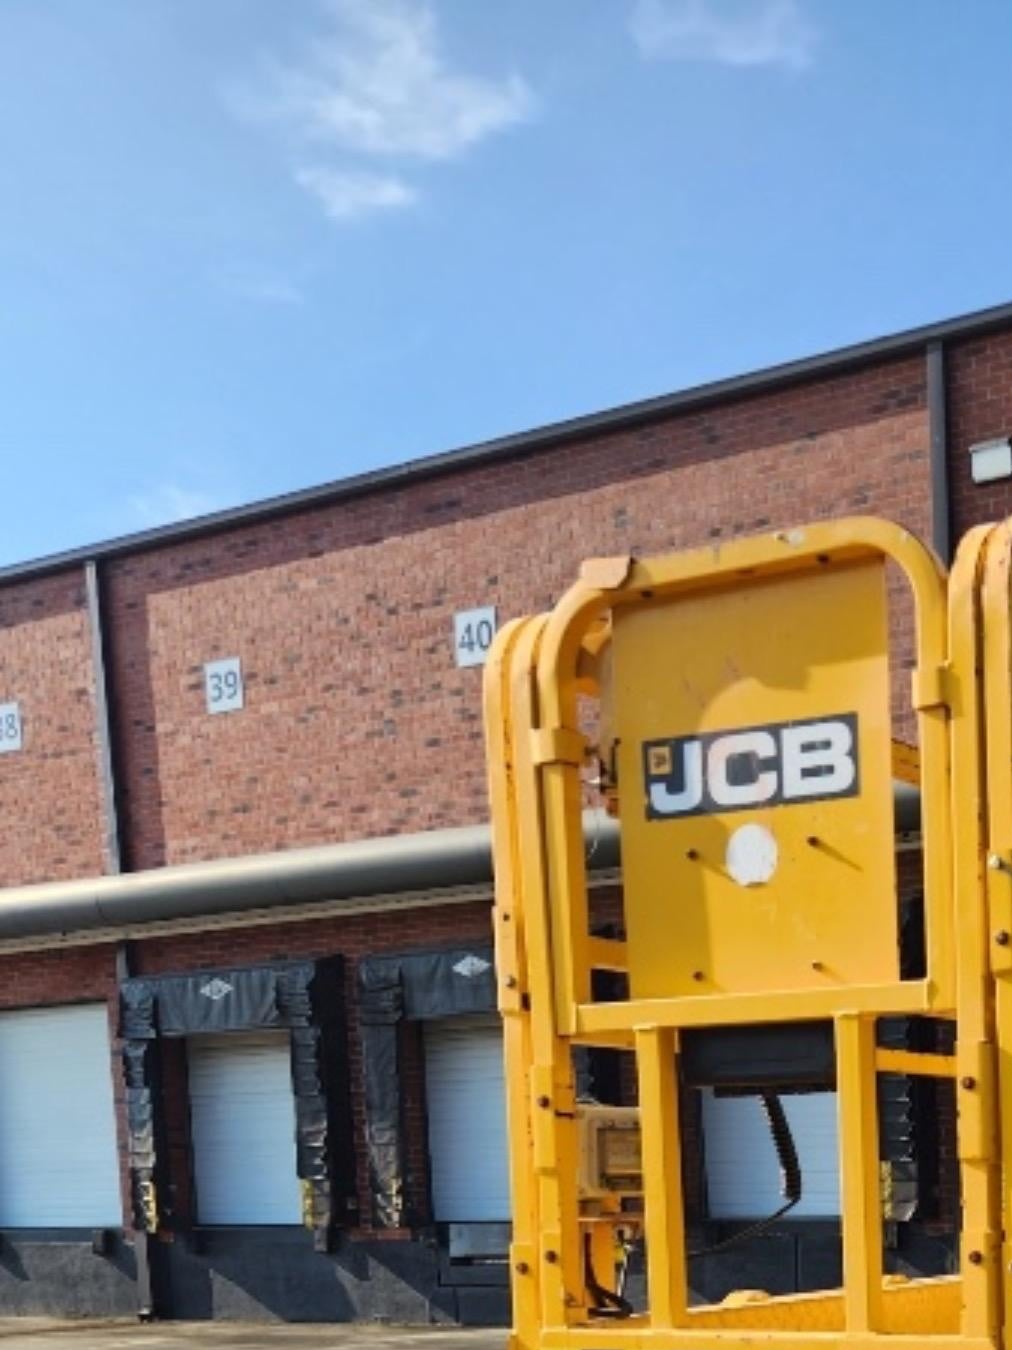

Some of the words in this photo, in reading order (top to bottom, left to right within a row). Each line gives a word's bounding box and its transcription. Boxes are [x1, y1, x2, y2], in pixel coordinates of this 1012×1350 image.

[459, 620, 493, 652] 40
[210, 671, 237, 703] 39
[0, 713, 18, 741] 8
[651, 722, 855, 813] JCB
